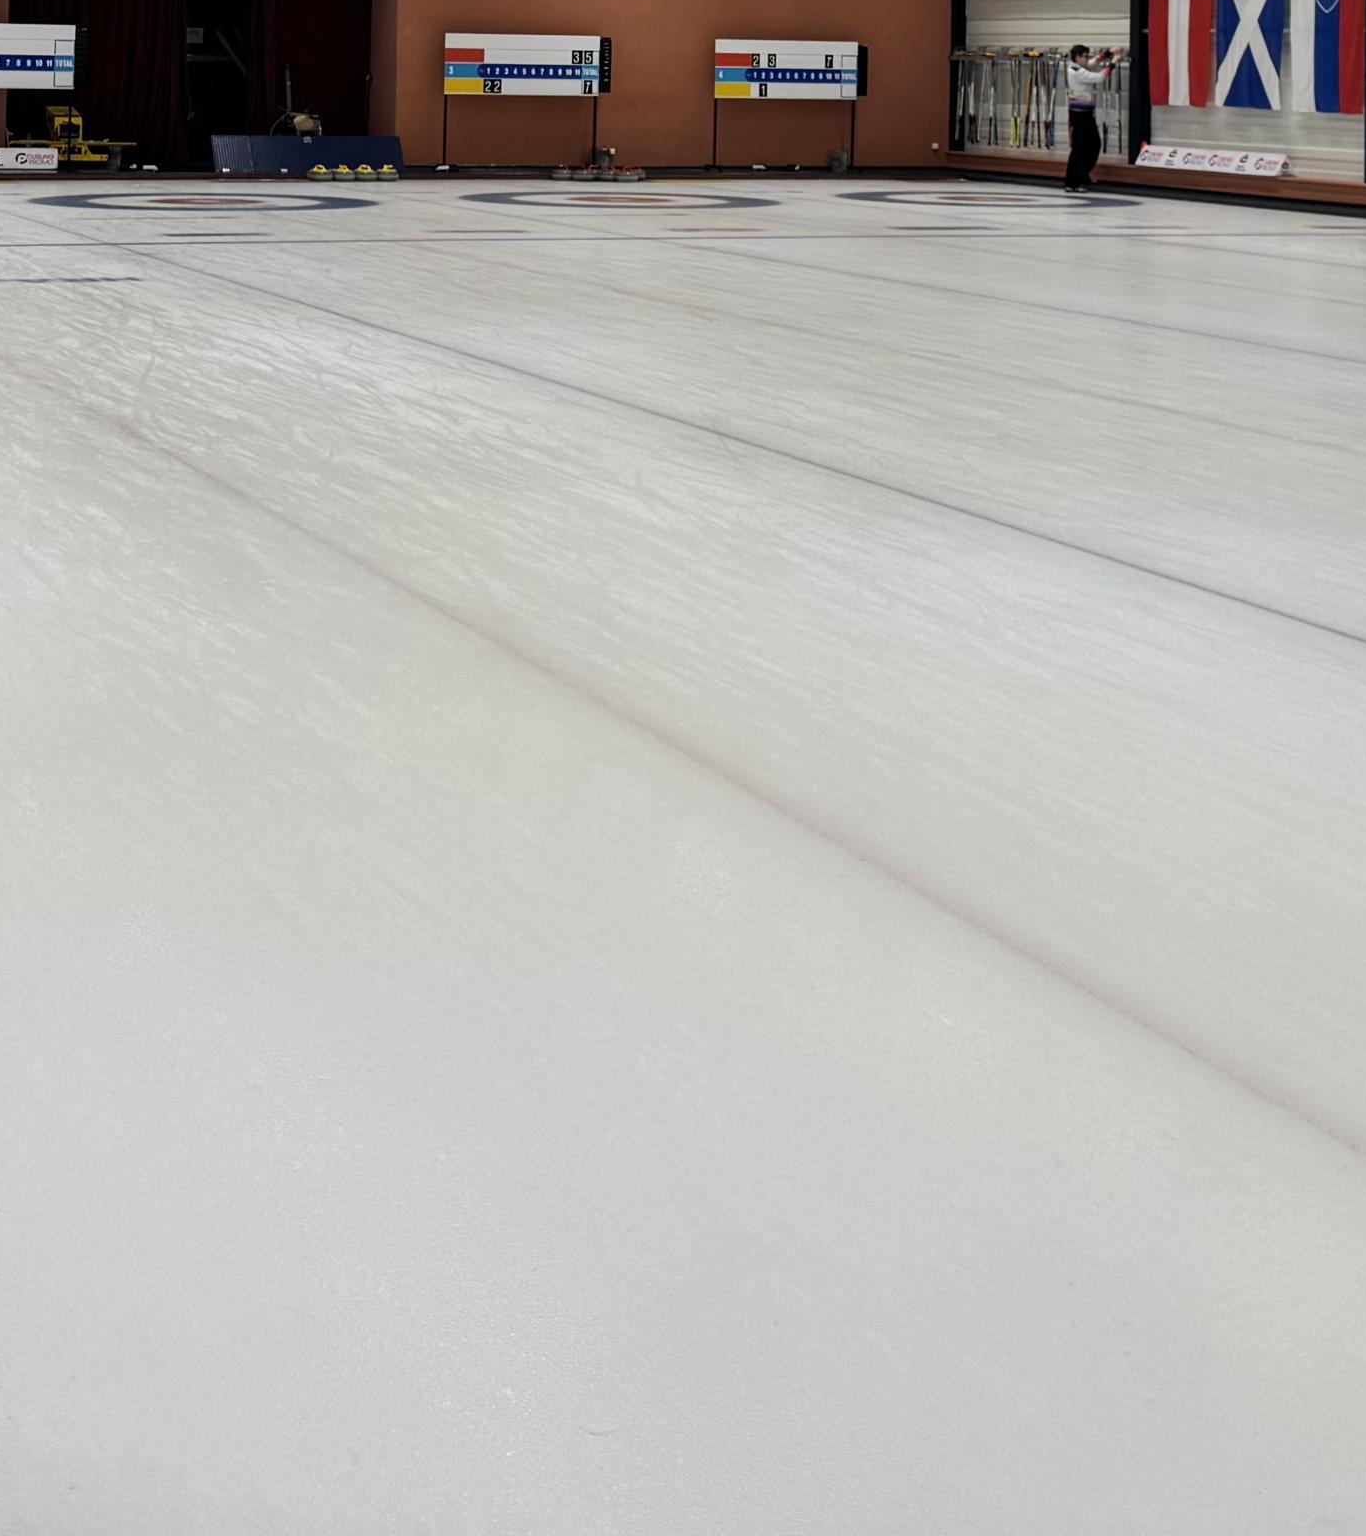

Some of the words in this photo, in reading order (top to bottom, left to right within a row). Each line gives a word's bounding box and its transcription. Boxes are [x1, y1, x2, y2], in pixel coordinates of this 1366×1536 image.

[573, 52, 580, 64] 3
[585, 52, 592, 64] 5
[752, 55, 759, 67] 2
[769, 55, 776, 67] 3
[484, 80, 492, 92] 2
[493, 81, 501, 93] 2
